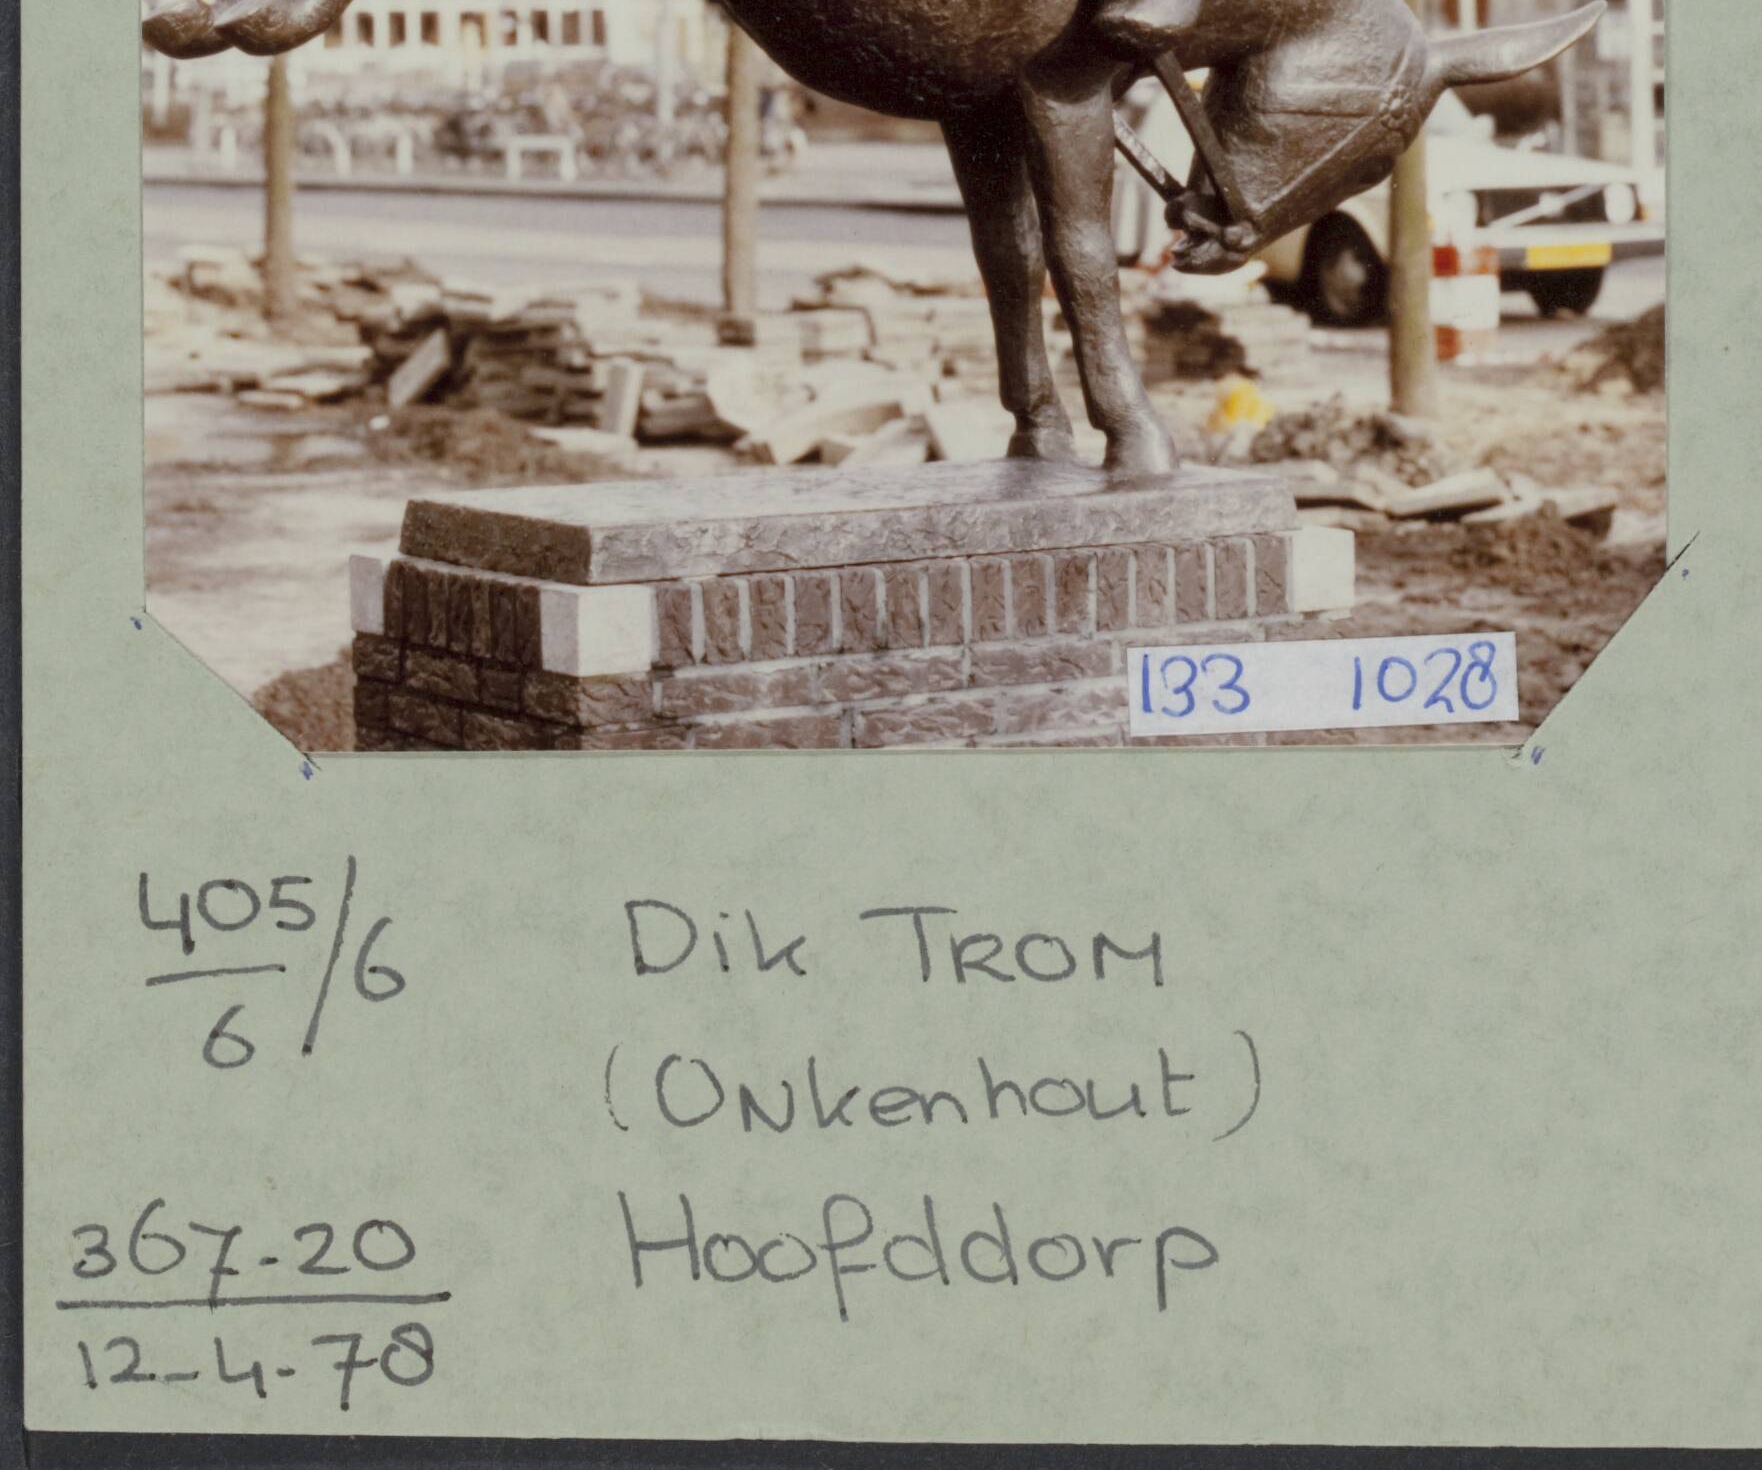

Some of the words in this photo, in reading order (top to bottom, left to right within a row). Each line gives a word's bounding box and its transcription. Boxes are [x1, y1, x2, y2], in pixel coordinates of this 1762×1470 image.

[1141, 653, 1251, 717] 133
[1352, 640, 1497, 713] 1028
[624, 899, 807, 977] Dik
[72, 1198, 416, 1306] 367-20
[617, 1191, 1219, 1322] Hoofddorp
[78, 1322, 434, 1412] 12-4-78
